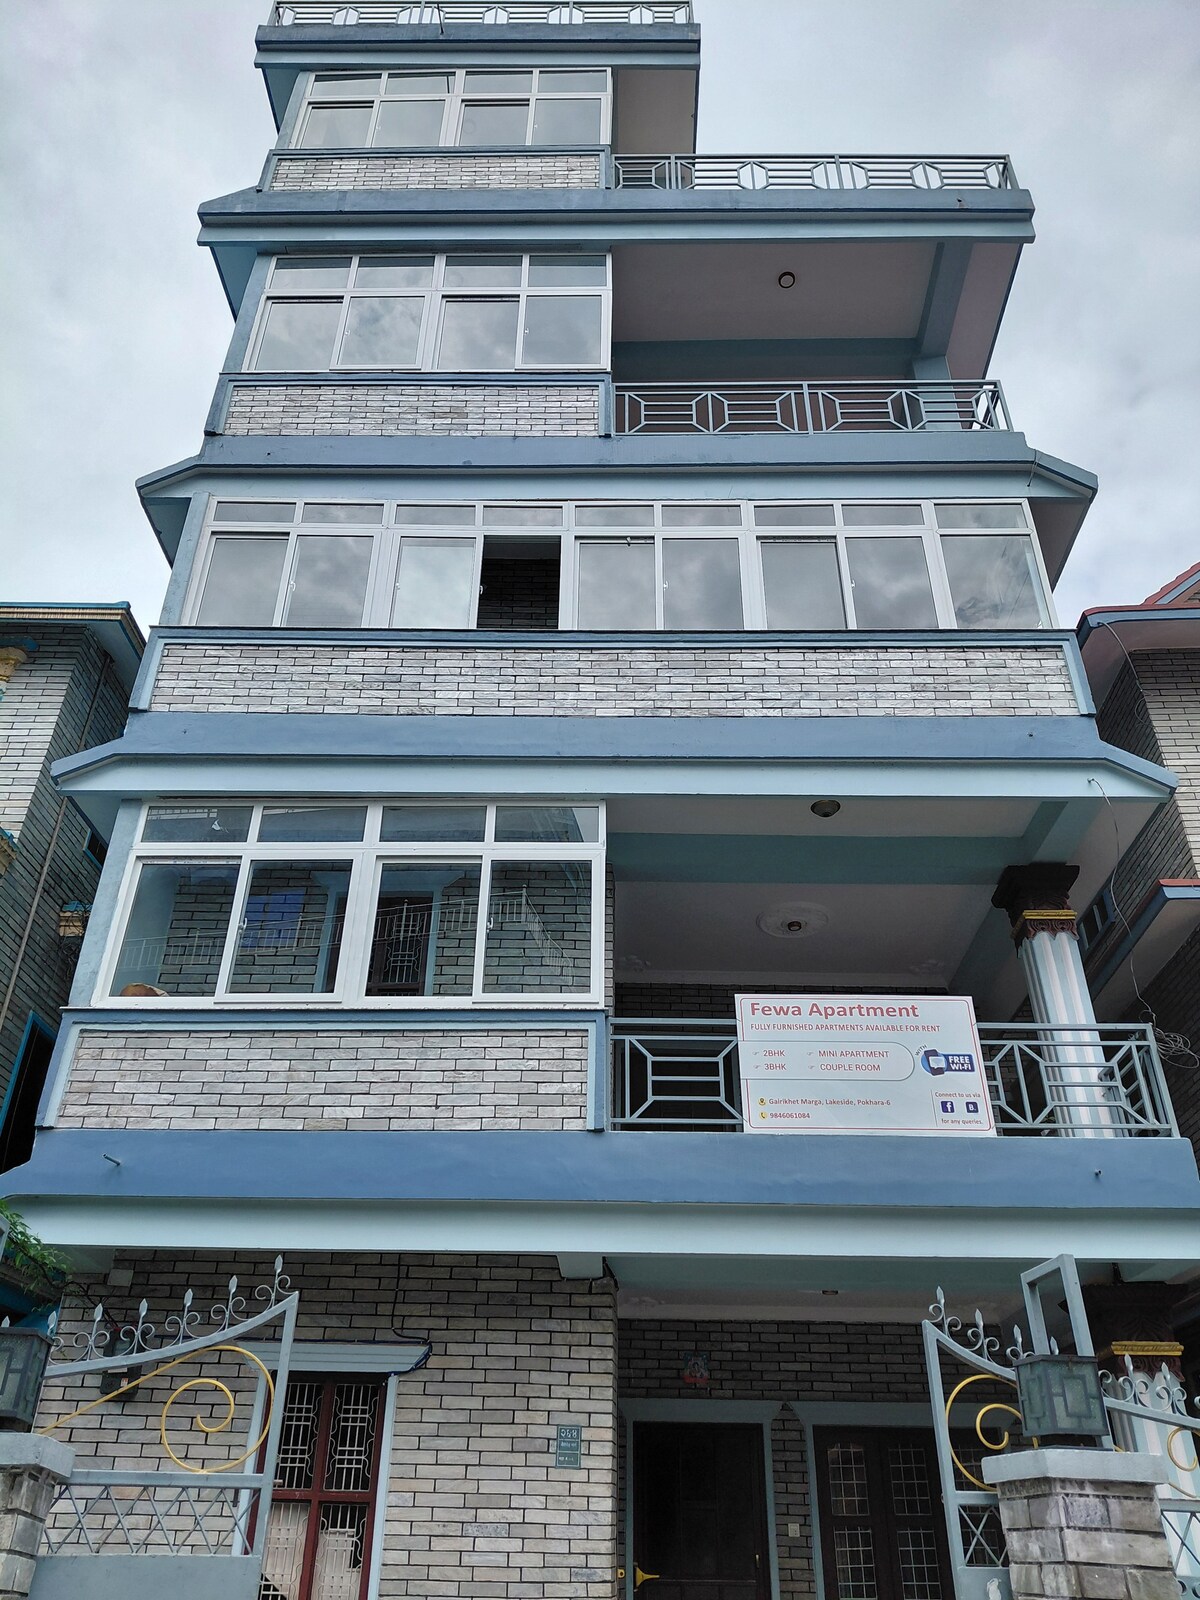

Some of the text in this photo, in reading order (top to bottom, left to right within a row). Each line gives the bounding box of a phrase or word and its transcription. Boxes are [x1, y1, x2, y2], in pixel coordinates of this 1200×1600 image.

[751, 1003, 919, 1019] Fewa Apartment
[772, 1023, 813, 1031] FURNISHED
[865, 1024, 903, 1032] AVAILABLE
[839, 1050, 889, 1058] APARTMENT
[915, 1044, 928, 1057] WITH
[948, 1055, 970, 1064] FREE
[764, 1063, 787, 1071] 3BHK
[820, 1063, 881, 1072] COUPLE ROOM
[950, 1063, 972, 1071] WI-FI
[800, 1098, 824, 1106] Marga,
[825, 1098, 856, 1107] Lakeside,
